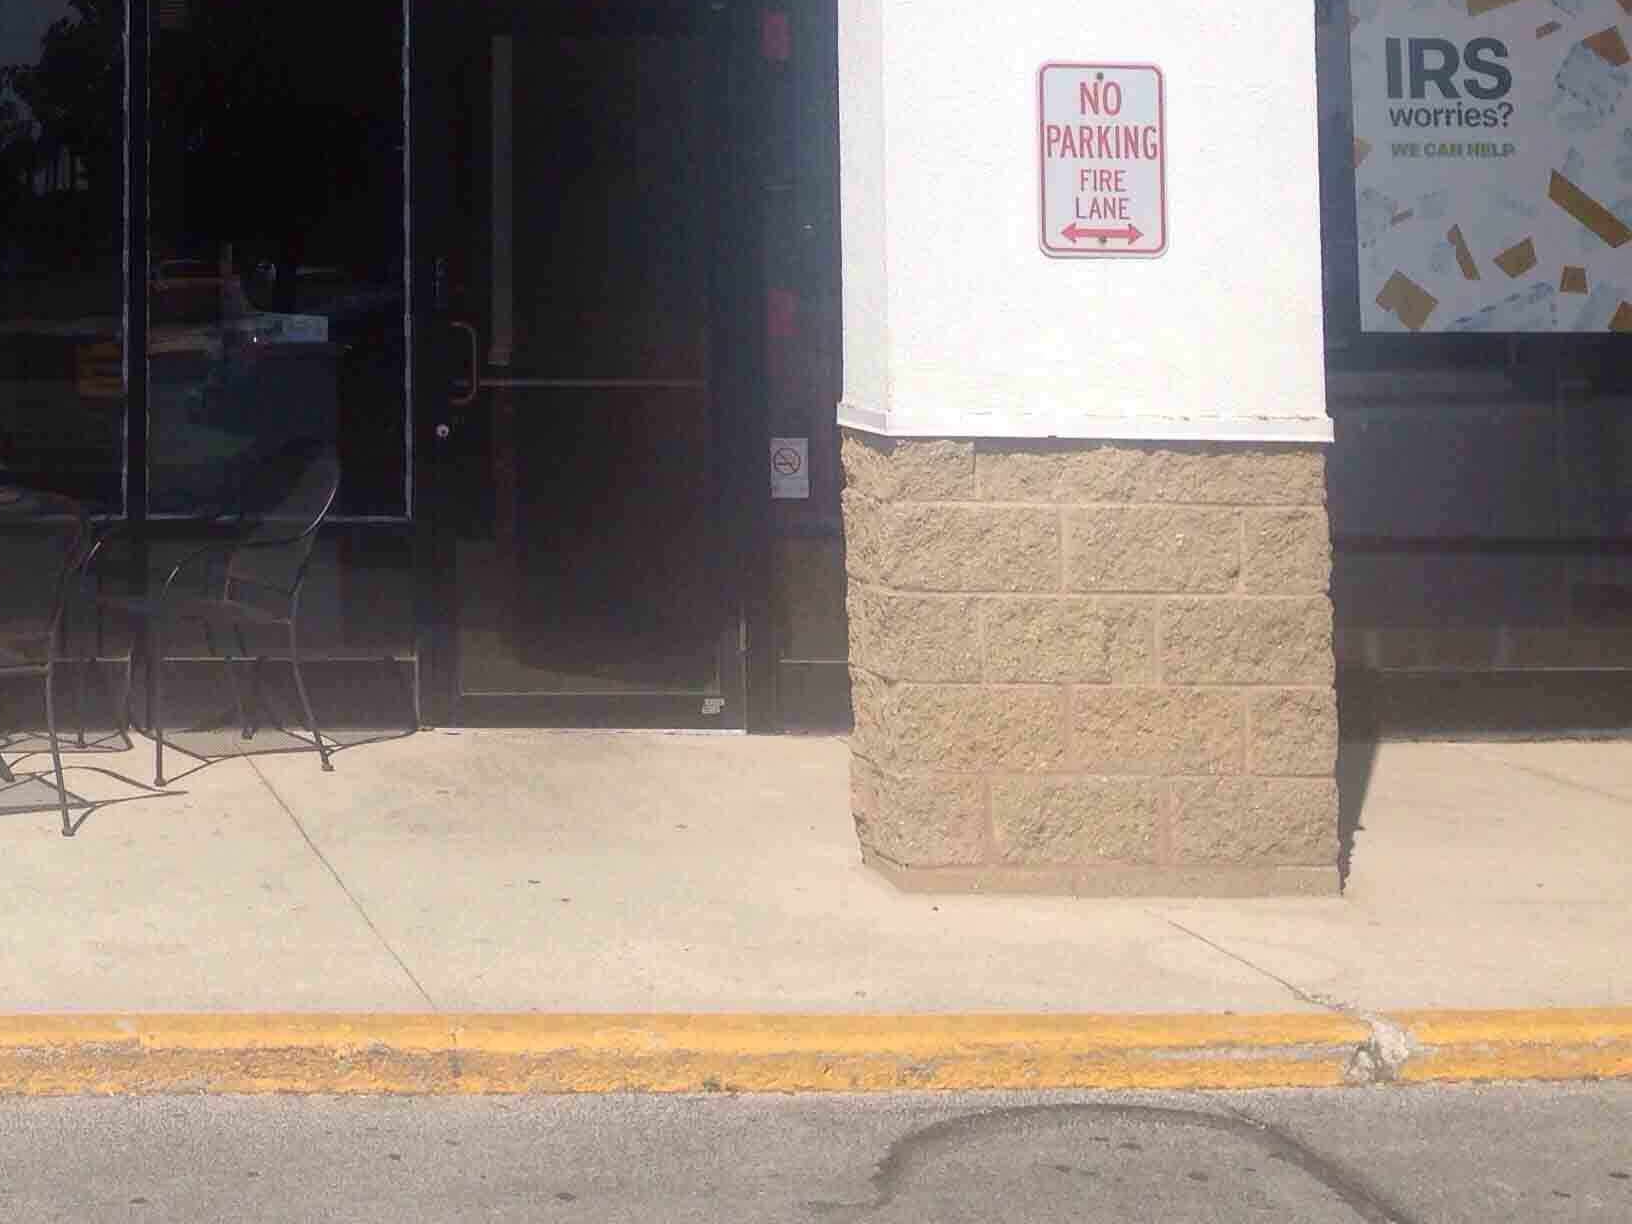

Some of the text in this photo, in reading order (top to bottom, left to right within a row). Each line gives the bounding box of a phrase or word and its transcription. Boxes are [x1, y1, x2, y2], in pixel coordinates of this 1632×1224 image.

[1384, 37, 1512, 100] IRS
[1079, 81, 1122, 116] NO
[1388, 102, 1514, 128] worries?
[1046, 124, 1158, 160] PARKING
[1391, 143, 1515, 158] WE CAN HELP
[1080, 168, 1127, 192] FIRE
[1075, 197, 1131, 220] LANE
